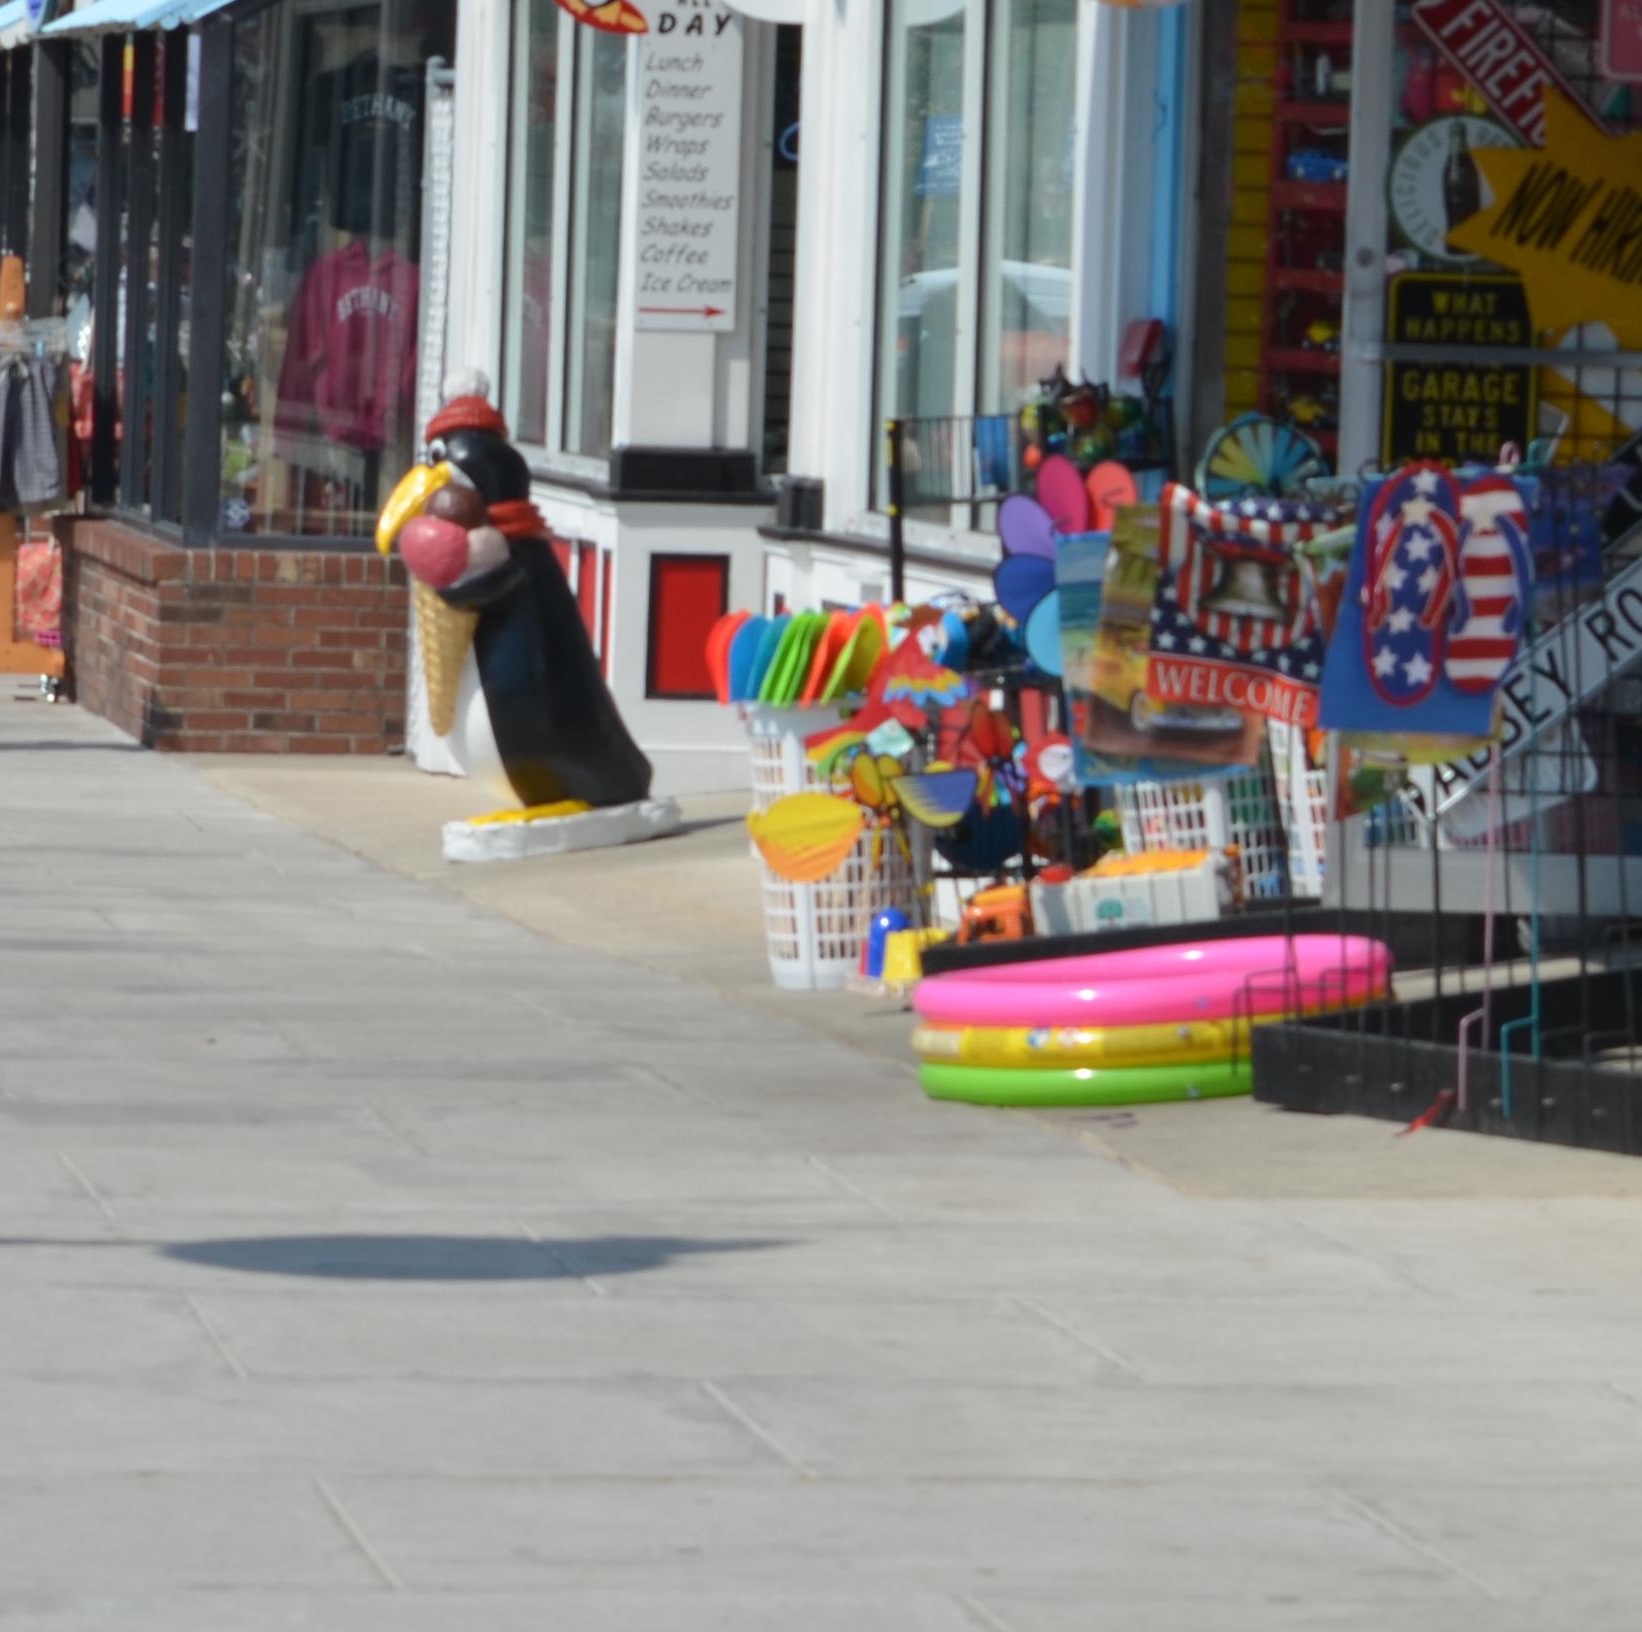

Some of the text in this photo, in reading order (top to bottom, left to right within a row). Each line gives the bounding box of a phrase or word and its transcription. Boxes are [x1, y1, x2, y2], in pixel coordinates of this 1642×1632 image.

[658, 12, 731, 37] DAY
[645, 52, 703, 72] Lunch
[645, 80, 712, 100] Dinner
[645, 106, 723, 132] Burgers
[646, 134, 709, 158] Wraps
[644, 161, 709, 182] Salads
[641, 189, 734, 210] Smoothies
[1489, 160, 1606, 252] NOW
[641, 216, 713, 237] Shakes
[640, 243, 708, 265] Coffee
[641, 273, 733, 293] Ice Cream
[1432, 292, 1498, 314] WHAT
[1404, 318, 1522, 344] HAPPENS
[1402, 370, 1521, 404] GARAGE
[1422, 404, 1500, 430] STAYS
[1157, 662, 1311, 726] WELCOME
